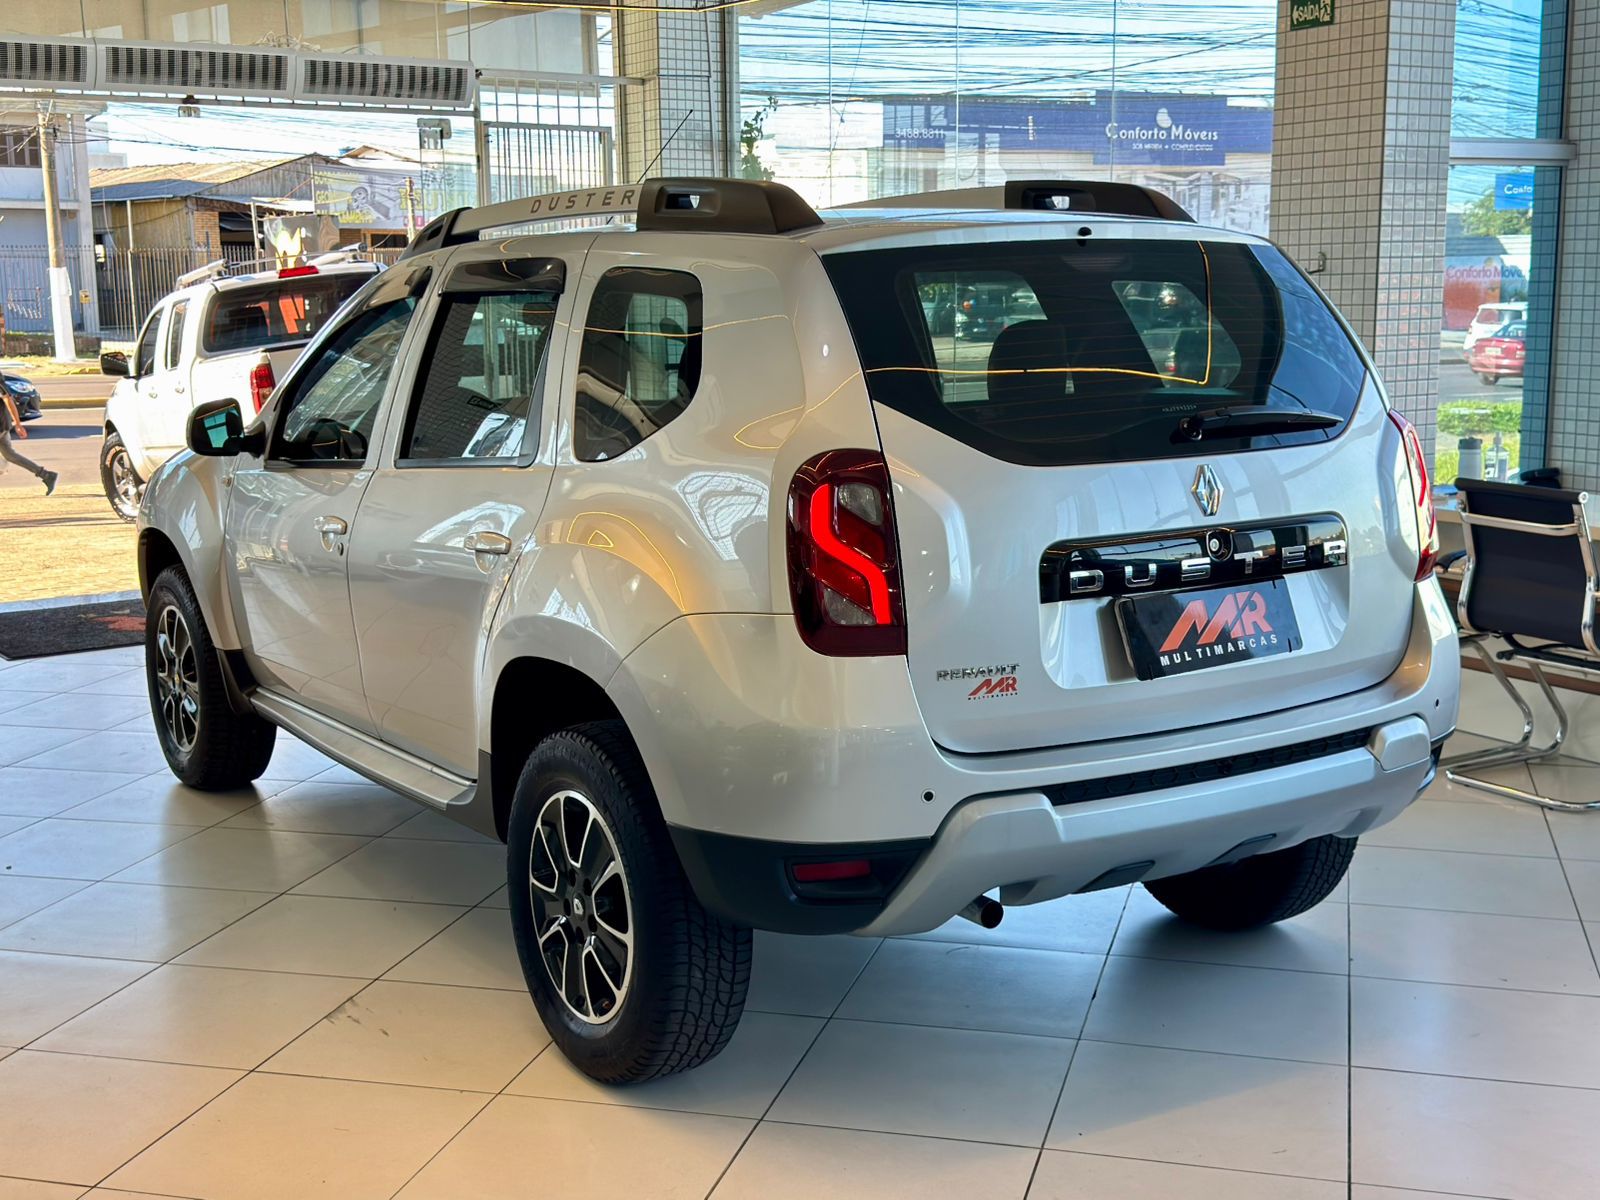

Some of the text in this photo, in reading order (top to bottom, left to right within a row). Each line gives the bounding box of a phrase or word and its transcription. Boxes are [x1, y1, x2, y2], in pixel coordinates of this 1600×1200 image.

[1298, 1, 1320, 22] SAÍDA
[1105, 122, 1219, 141] Conforto Móveis
[530, 189, 635, 213] DUSTER
[1069, 540, 1347, 594] DUSTER
[1159, 634, 1278, 667] MULTIMARCAS
[936, 663, 1020, 681] RENAULT
